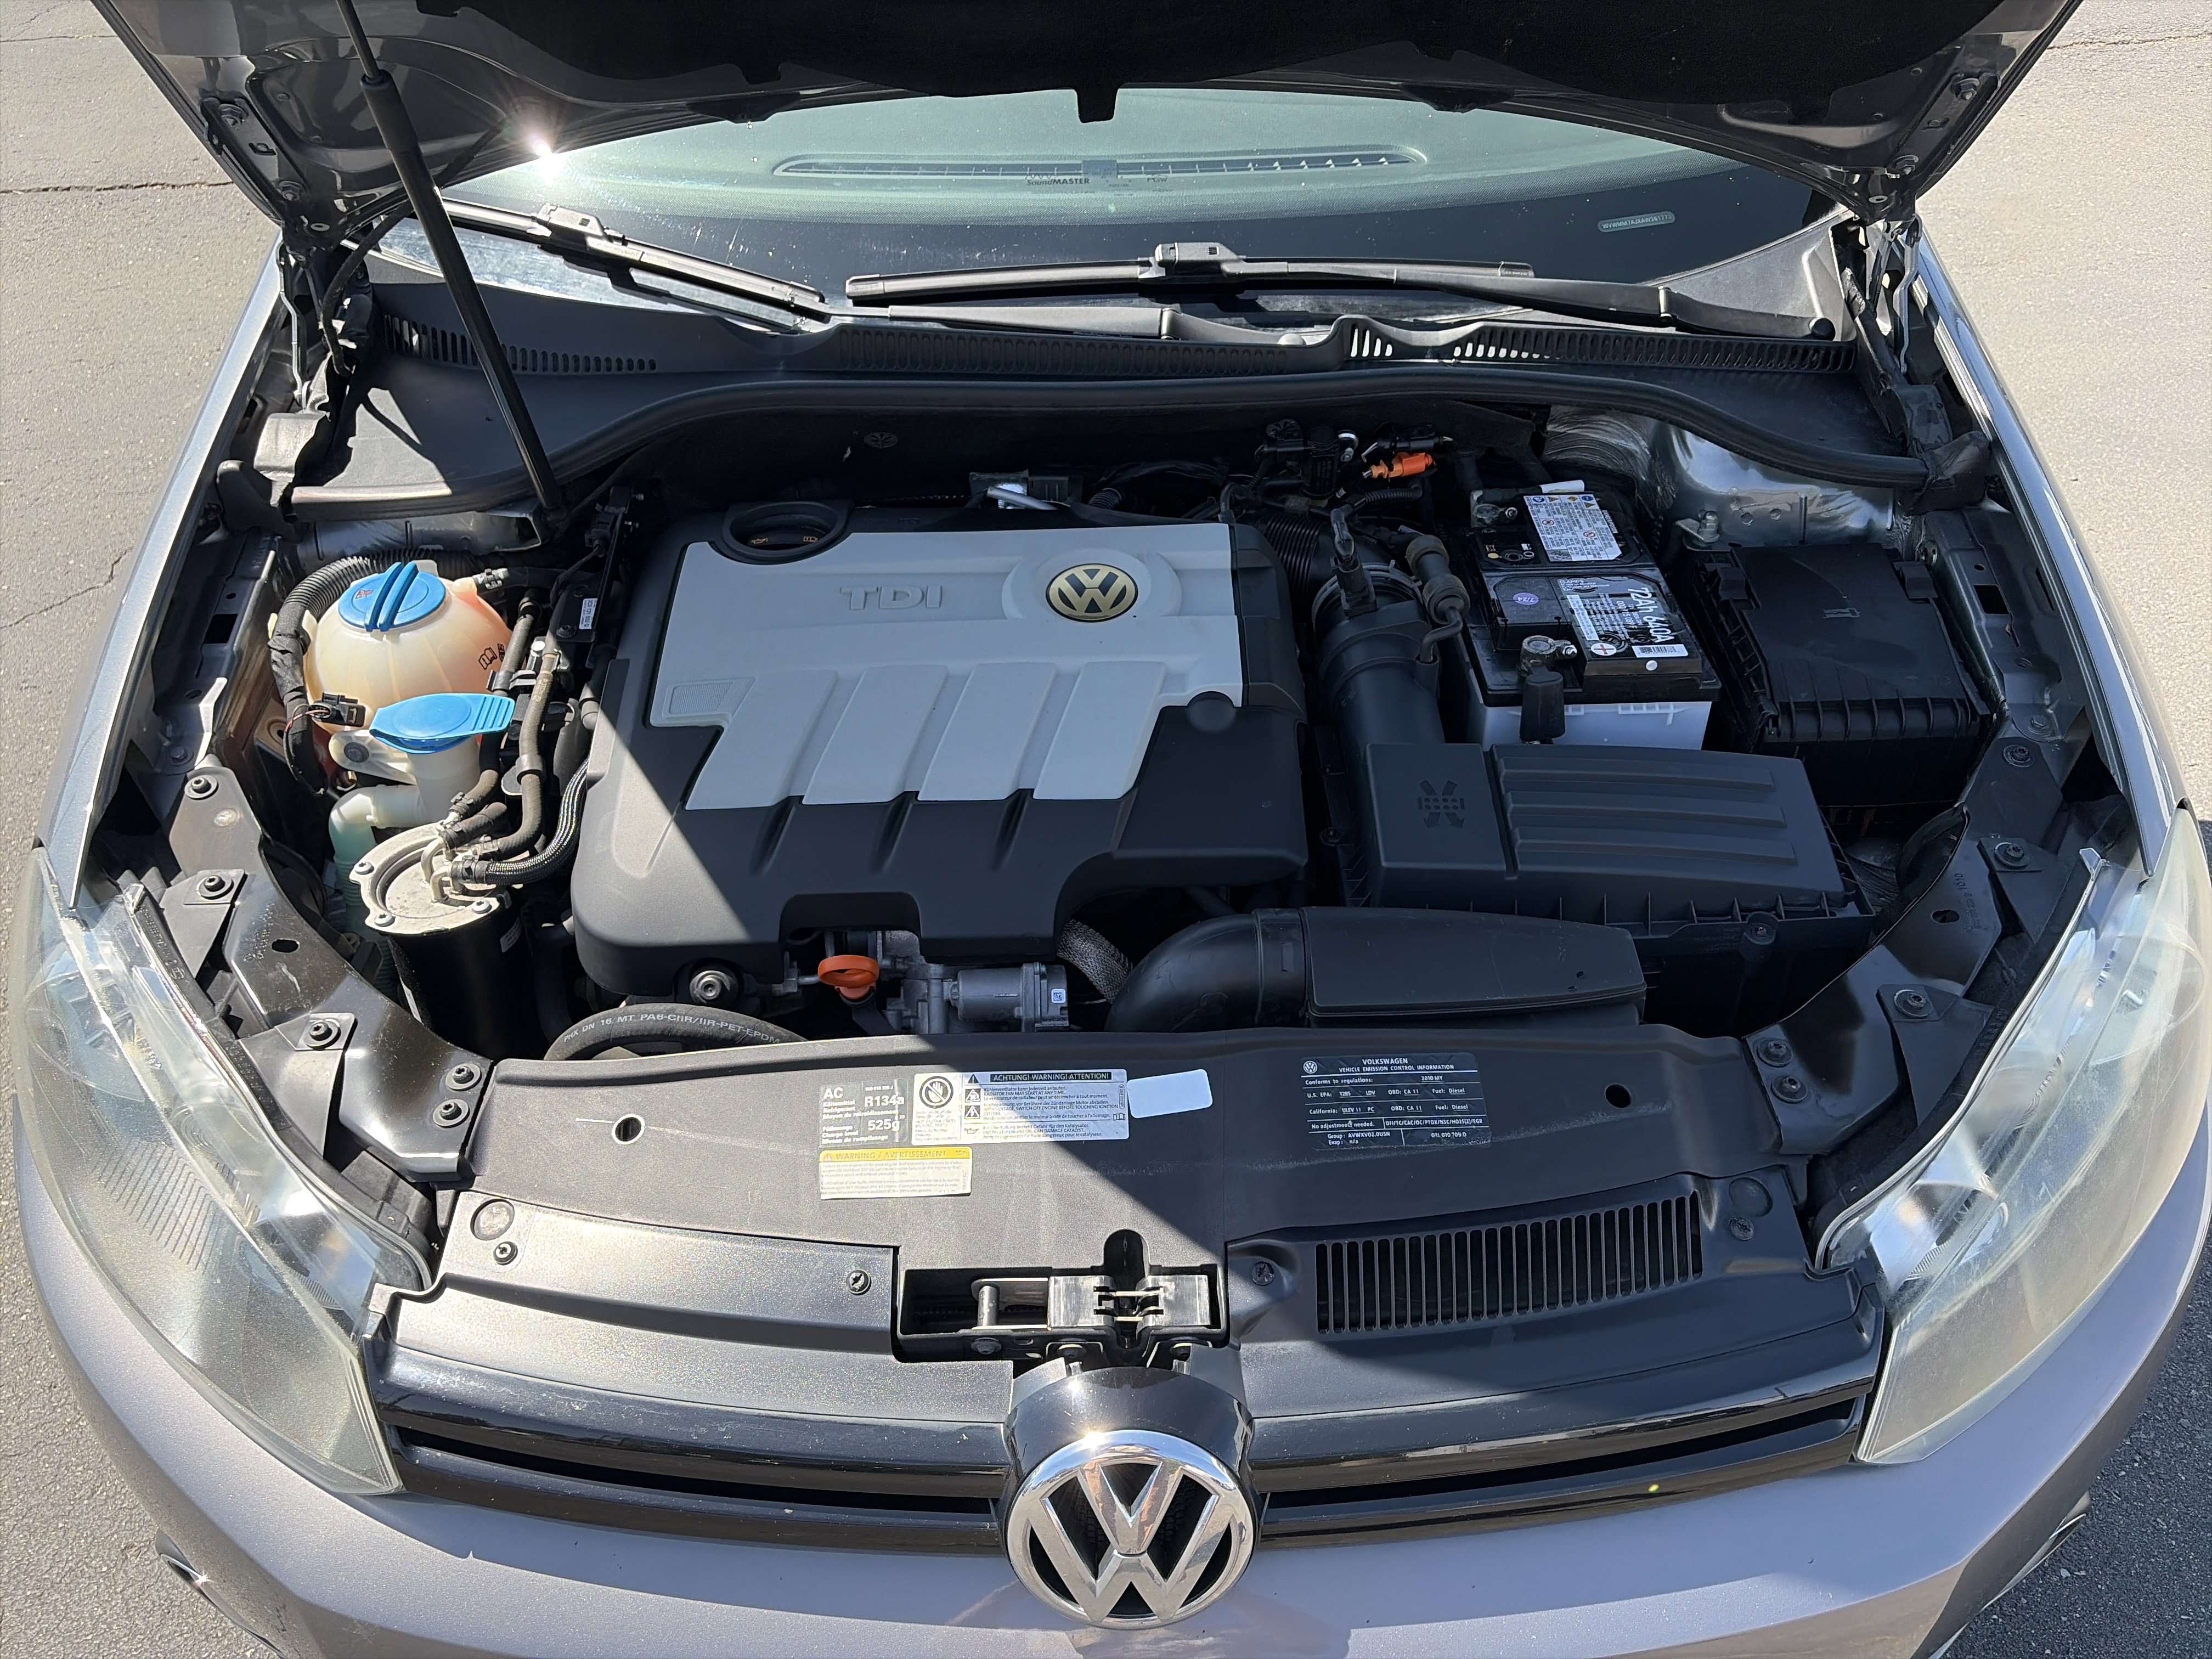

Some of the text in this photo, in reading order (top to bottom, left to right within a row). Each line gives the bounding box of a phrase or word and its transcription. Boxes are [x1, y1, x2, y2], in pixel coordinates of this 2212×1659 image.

[840, 585, 943, 610] TDI
[1046, 563, 1138, 623] VW
[1627, 587, 1658, 613] 72Ah
[1643, 616, 1675, 643] 640A
[563, 1030, 579, 1042] PHX
[582, 1022, 595, 1032] DN
[1304, 1060, 1317, 1074] VW
[823, 1087, 844, 1099] AC
[865, 1094, 905, 1107] R134a
[868, 1119, 900, 1131] 525g
[1007, 1430, 1254, 1629] VW
